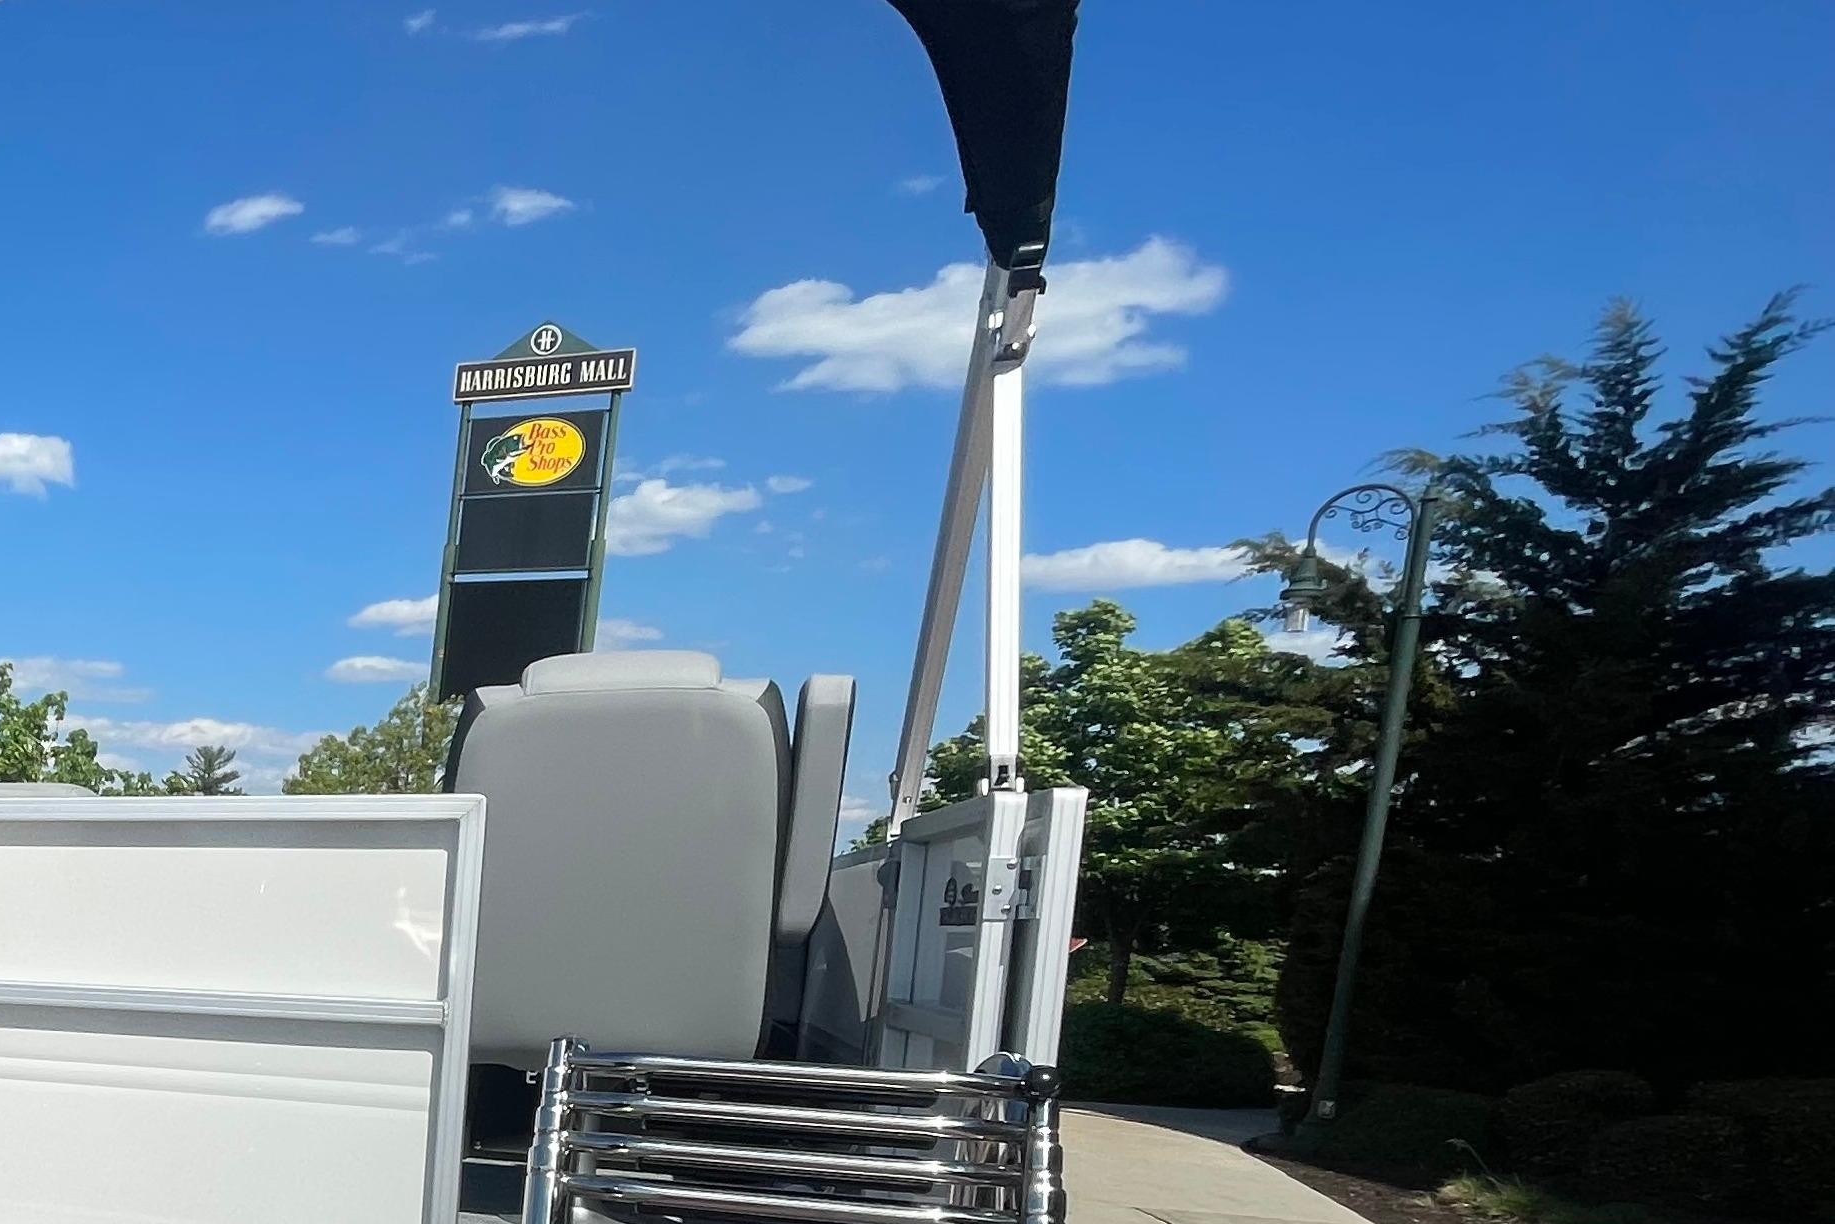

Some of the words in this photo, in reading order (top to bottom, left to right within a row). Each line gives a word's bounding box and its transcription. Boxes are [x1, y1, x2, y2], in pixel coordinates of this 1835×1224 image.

[459, 362, 573, 393] HARRISBURG
[579, 357, 628, 384] MALL
[528, 422, 567, 441] Bass
[528, 440, 556, 456] Pro
[526, 455, 574, 474] Shops
